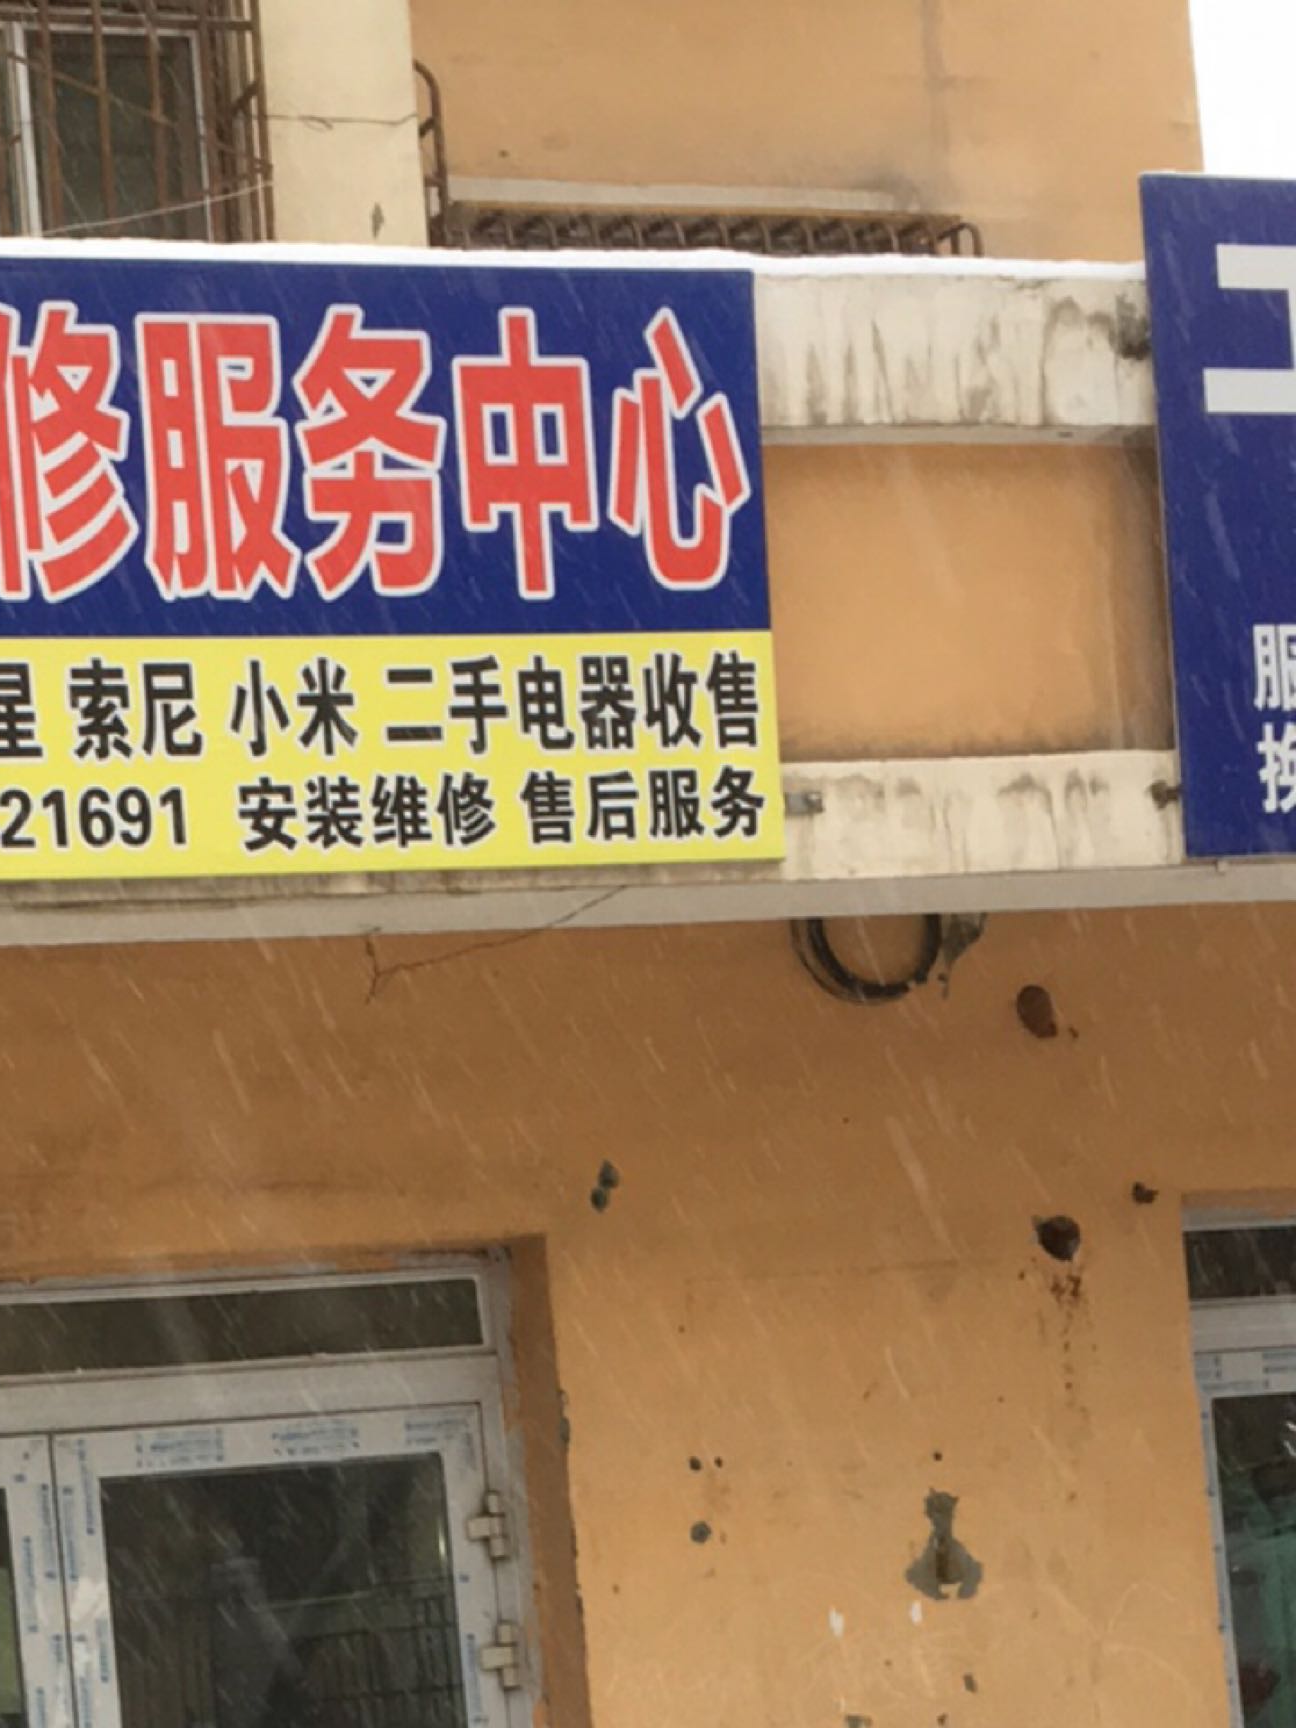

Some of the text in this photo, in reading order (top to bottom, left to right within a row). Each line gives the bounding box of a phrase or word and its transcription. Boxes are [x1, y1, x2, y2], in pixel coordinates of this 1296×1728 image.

[68, 659, 203, 759] 索尼
[230, 657, 358, 757] 小米
[386, 652, 760, 754] 二手电器收售
[239, 772, 497, 851] 安装维修
[520, 766, 765, 845] 售后服务
